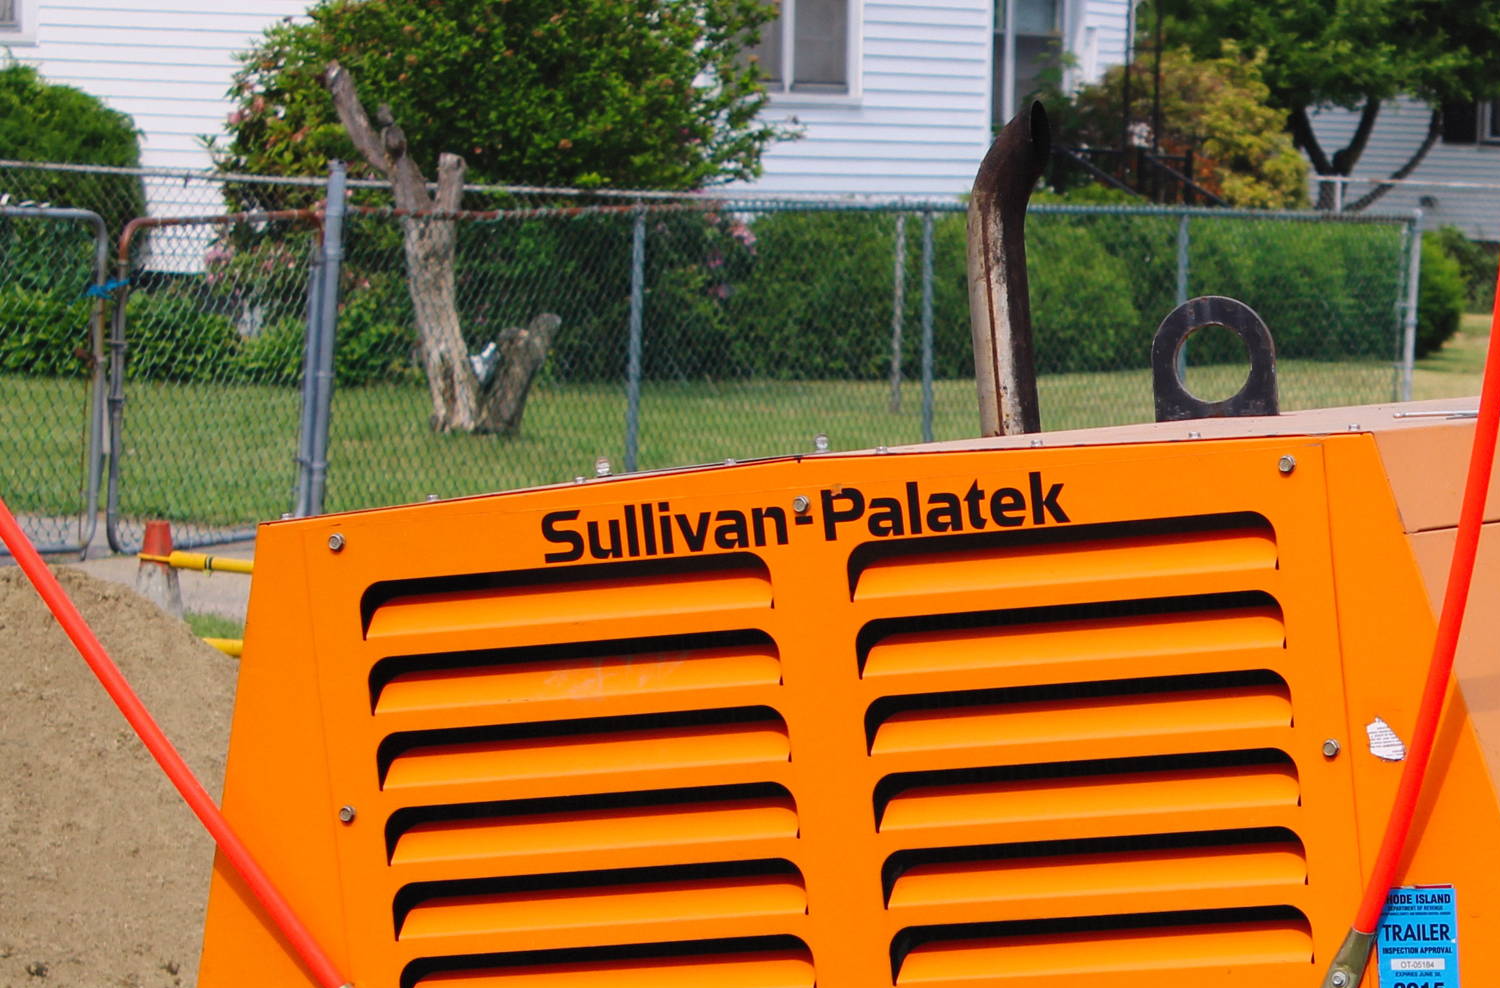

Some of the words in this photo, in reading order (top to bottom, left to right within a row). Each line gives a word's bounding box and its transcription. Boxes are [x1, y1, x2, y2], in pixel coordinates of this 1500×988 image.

[541, 471, 1072, 564] Sullivan-Palatek
[1386, 894, 1412, 904] HODE
[1415, 893, 1451, 904] ISLAND
[1382, 924, 1450, 942] TRAILER
[1382, 947, 1419, 955] INSPECTION
[1419, 946, 1453, 954] APPROVAL
